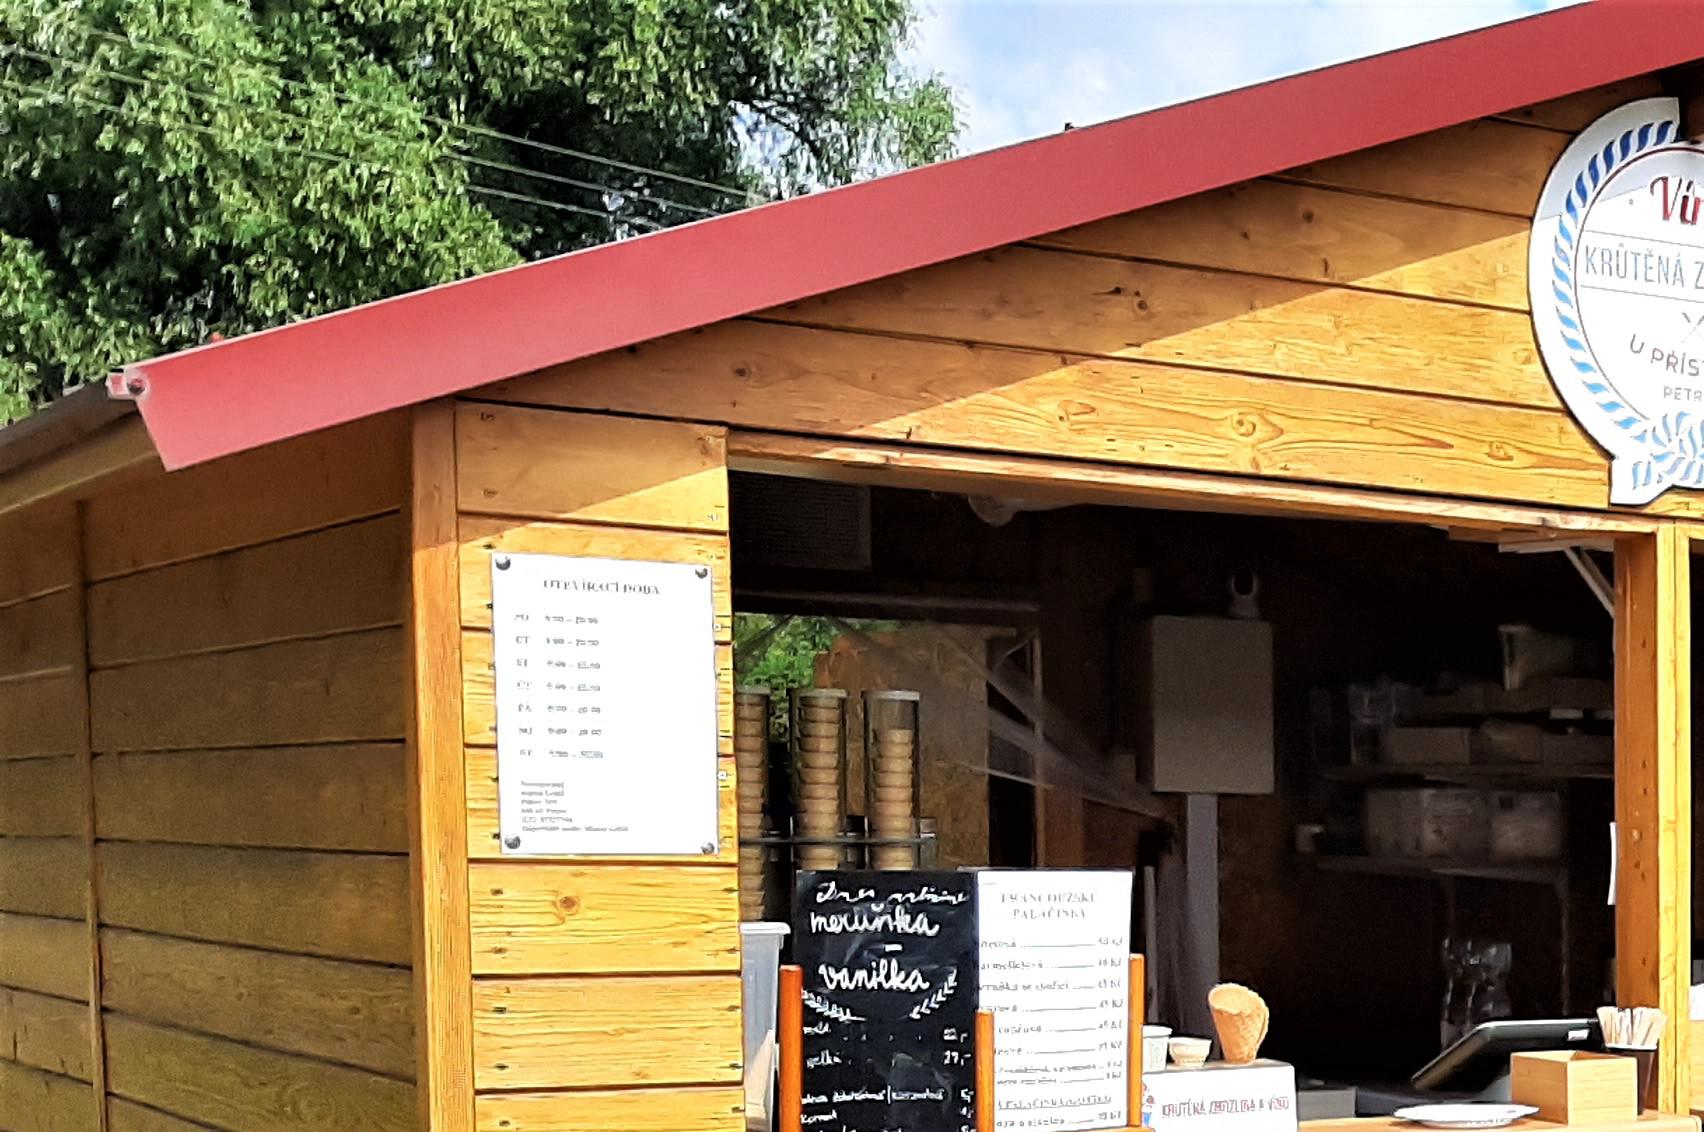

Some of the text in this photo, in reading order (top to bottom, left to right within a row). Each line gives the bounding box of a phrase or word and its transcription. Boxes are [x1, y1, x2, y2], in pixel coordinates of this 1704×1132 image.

[1630, 333, 1645, 354] U
[810, 903, 940, 936] meruňka
[817, 957, 930, 992] vanilka
